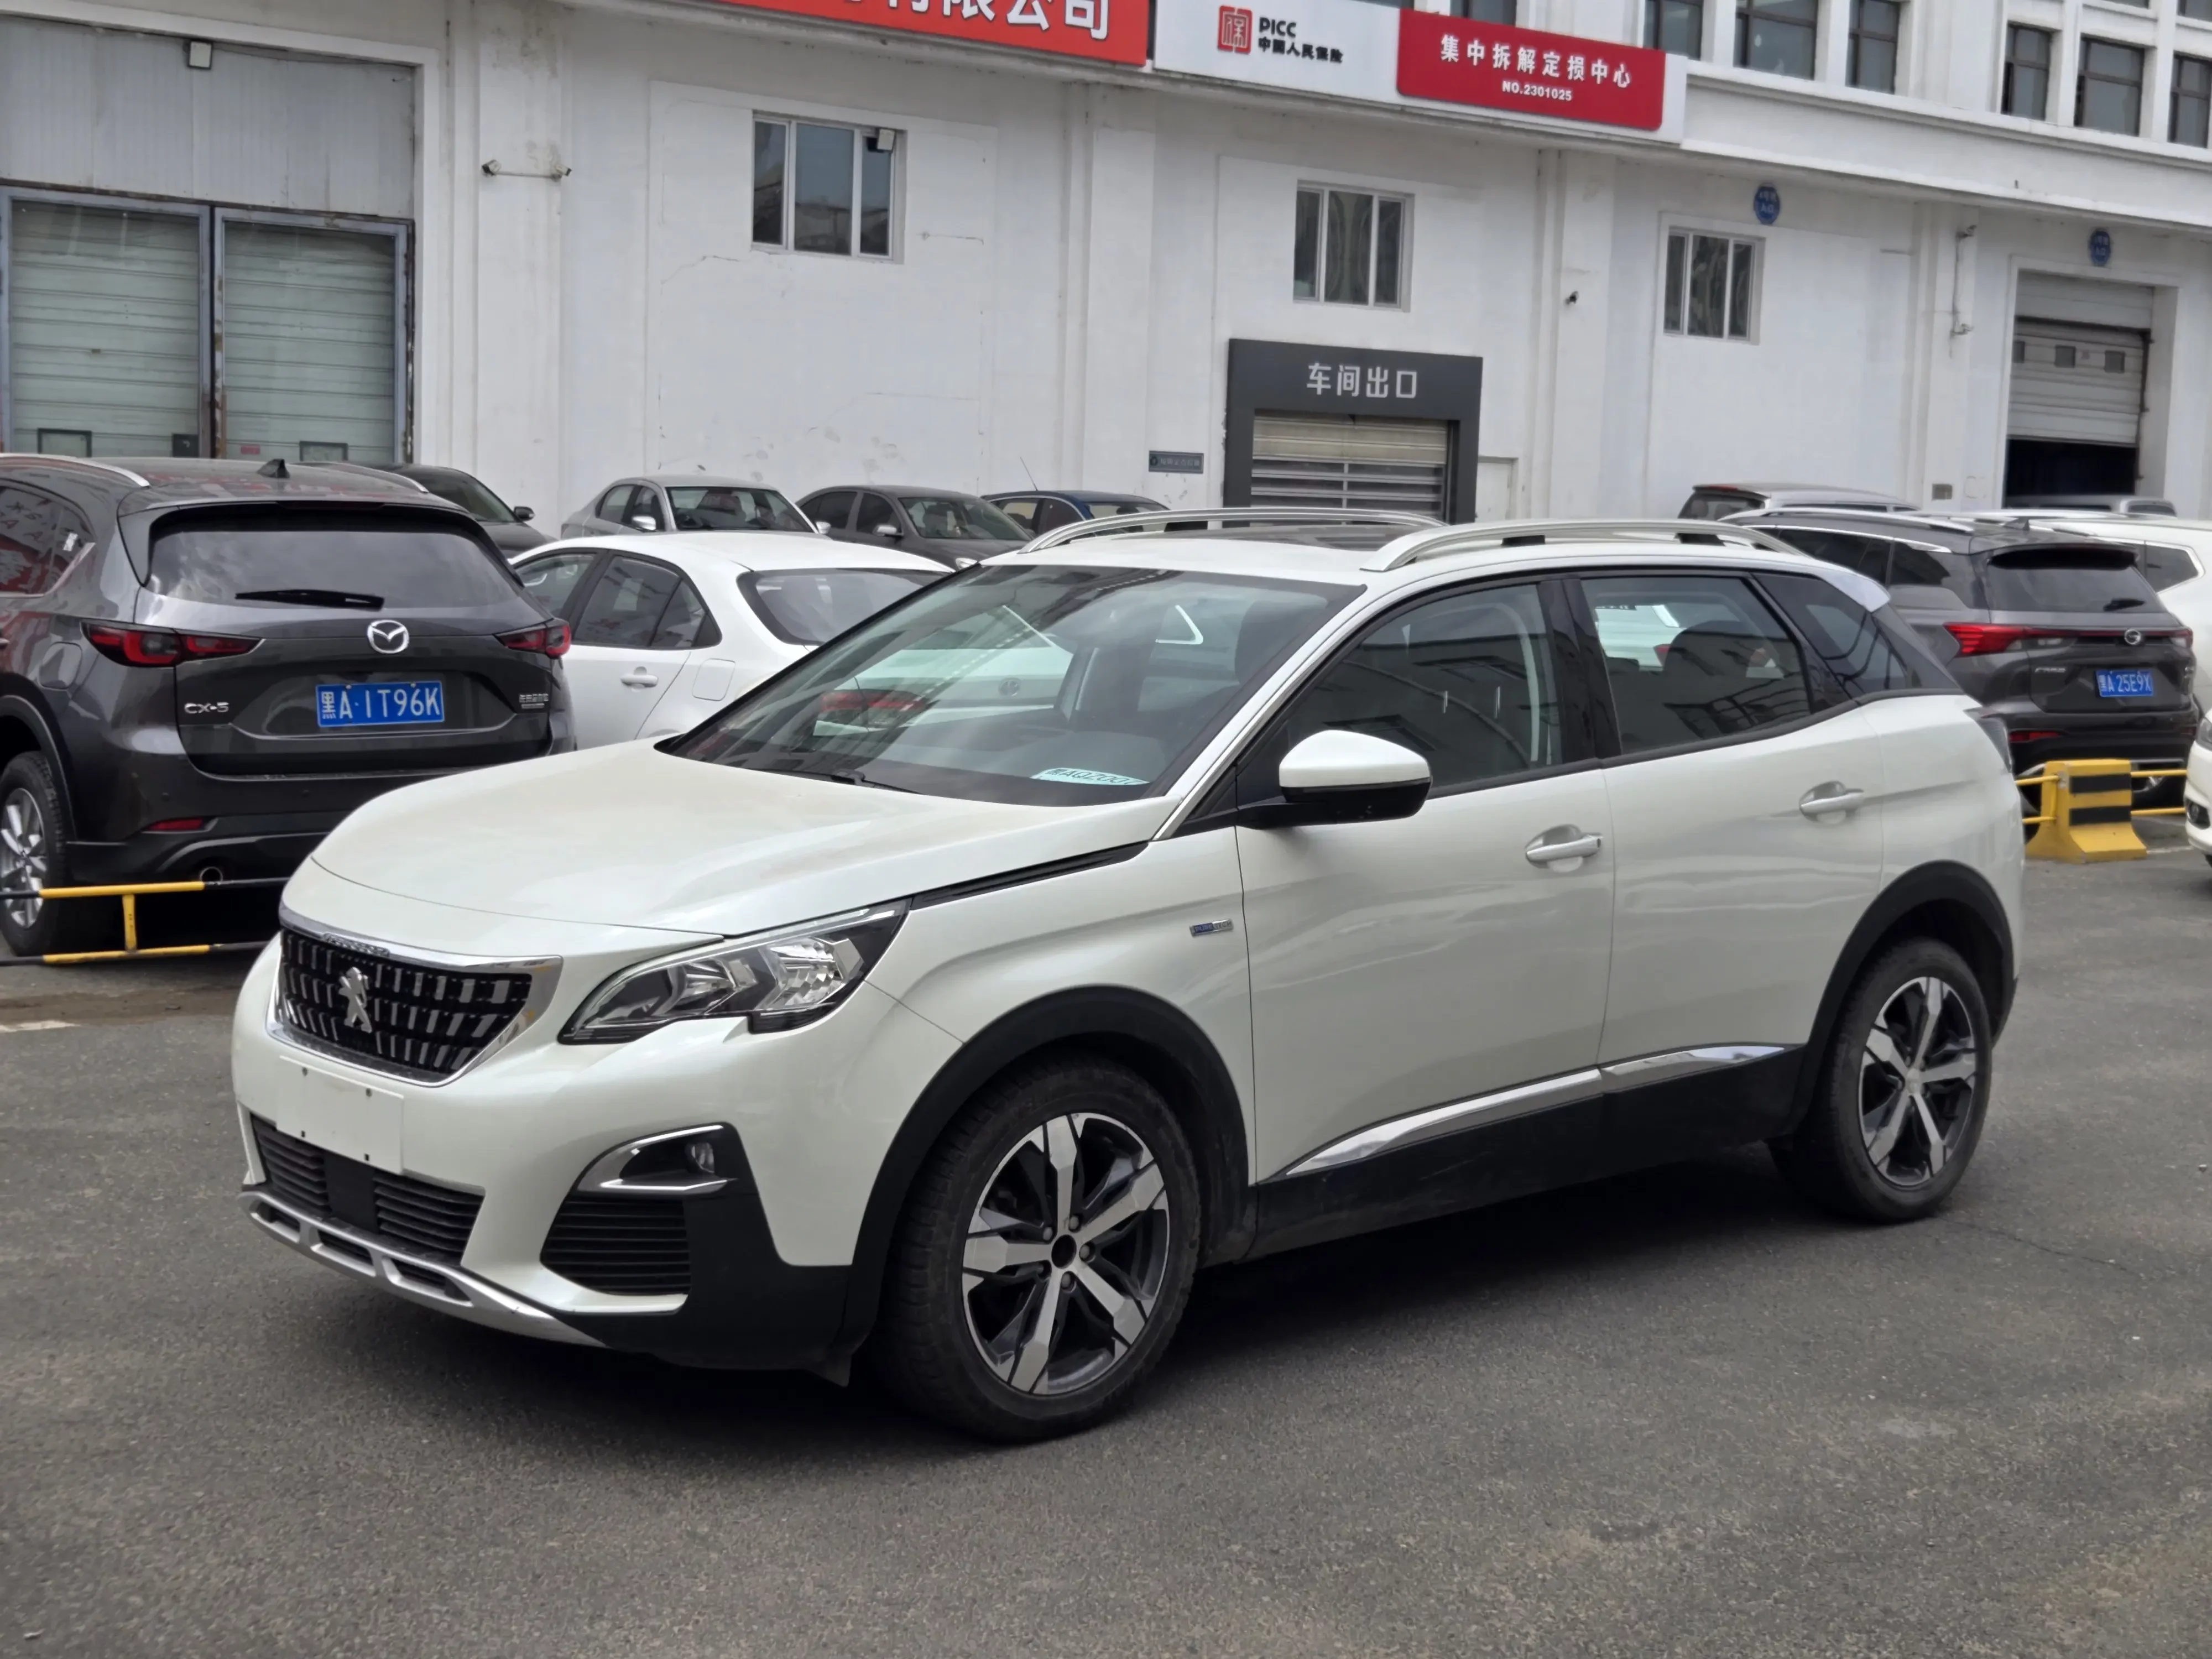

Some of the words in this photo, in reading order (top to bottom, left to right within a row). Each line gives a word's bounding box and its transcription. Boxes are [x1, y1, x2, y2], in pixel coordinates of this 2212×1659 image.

[888, 0, 1108, 40] 公司
[1259, 17, 1297, 38] PICC
[1258, 36, 1343, 64] 中国人民保险
[1441, 34, 1630, 88] 集中拆解定损中心
[1502, 81, 1572, 101] NO.2301025
[1307, 363, 1417, 398] 车间出口
[184, 702, 229, 714] CX-5
